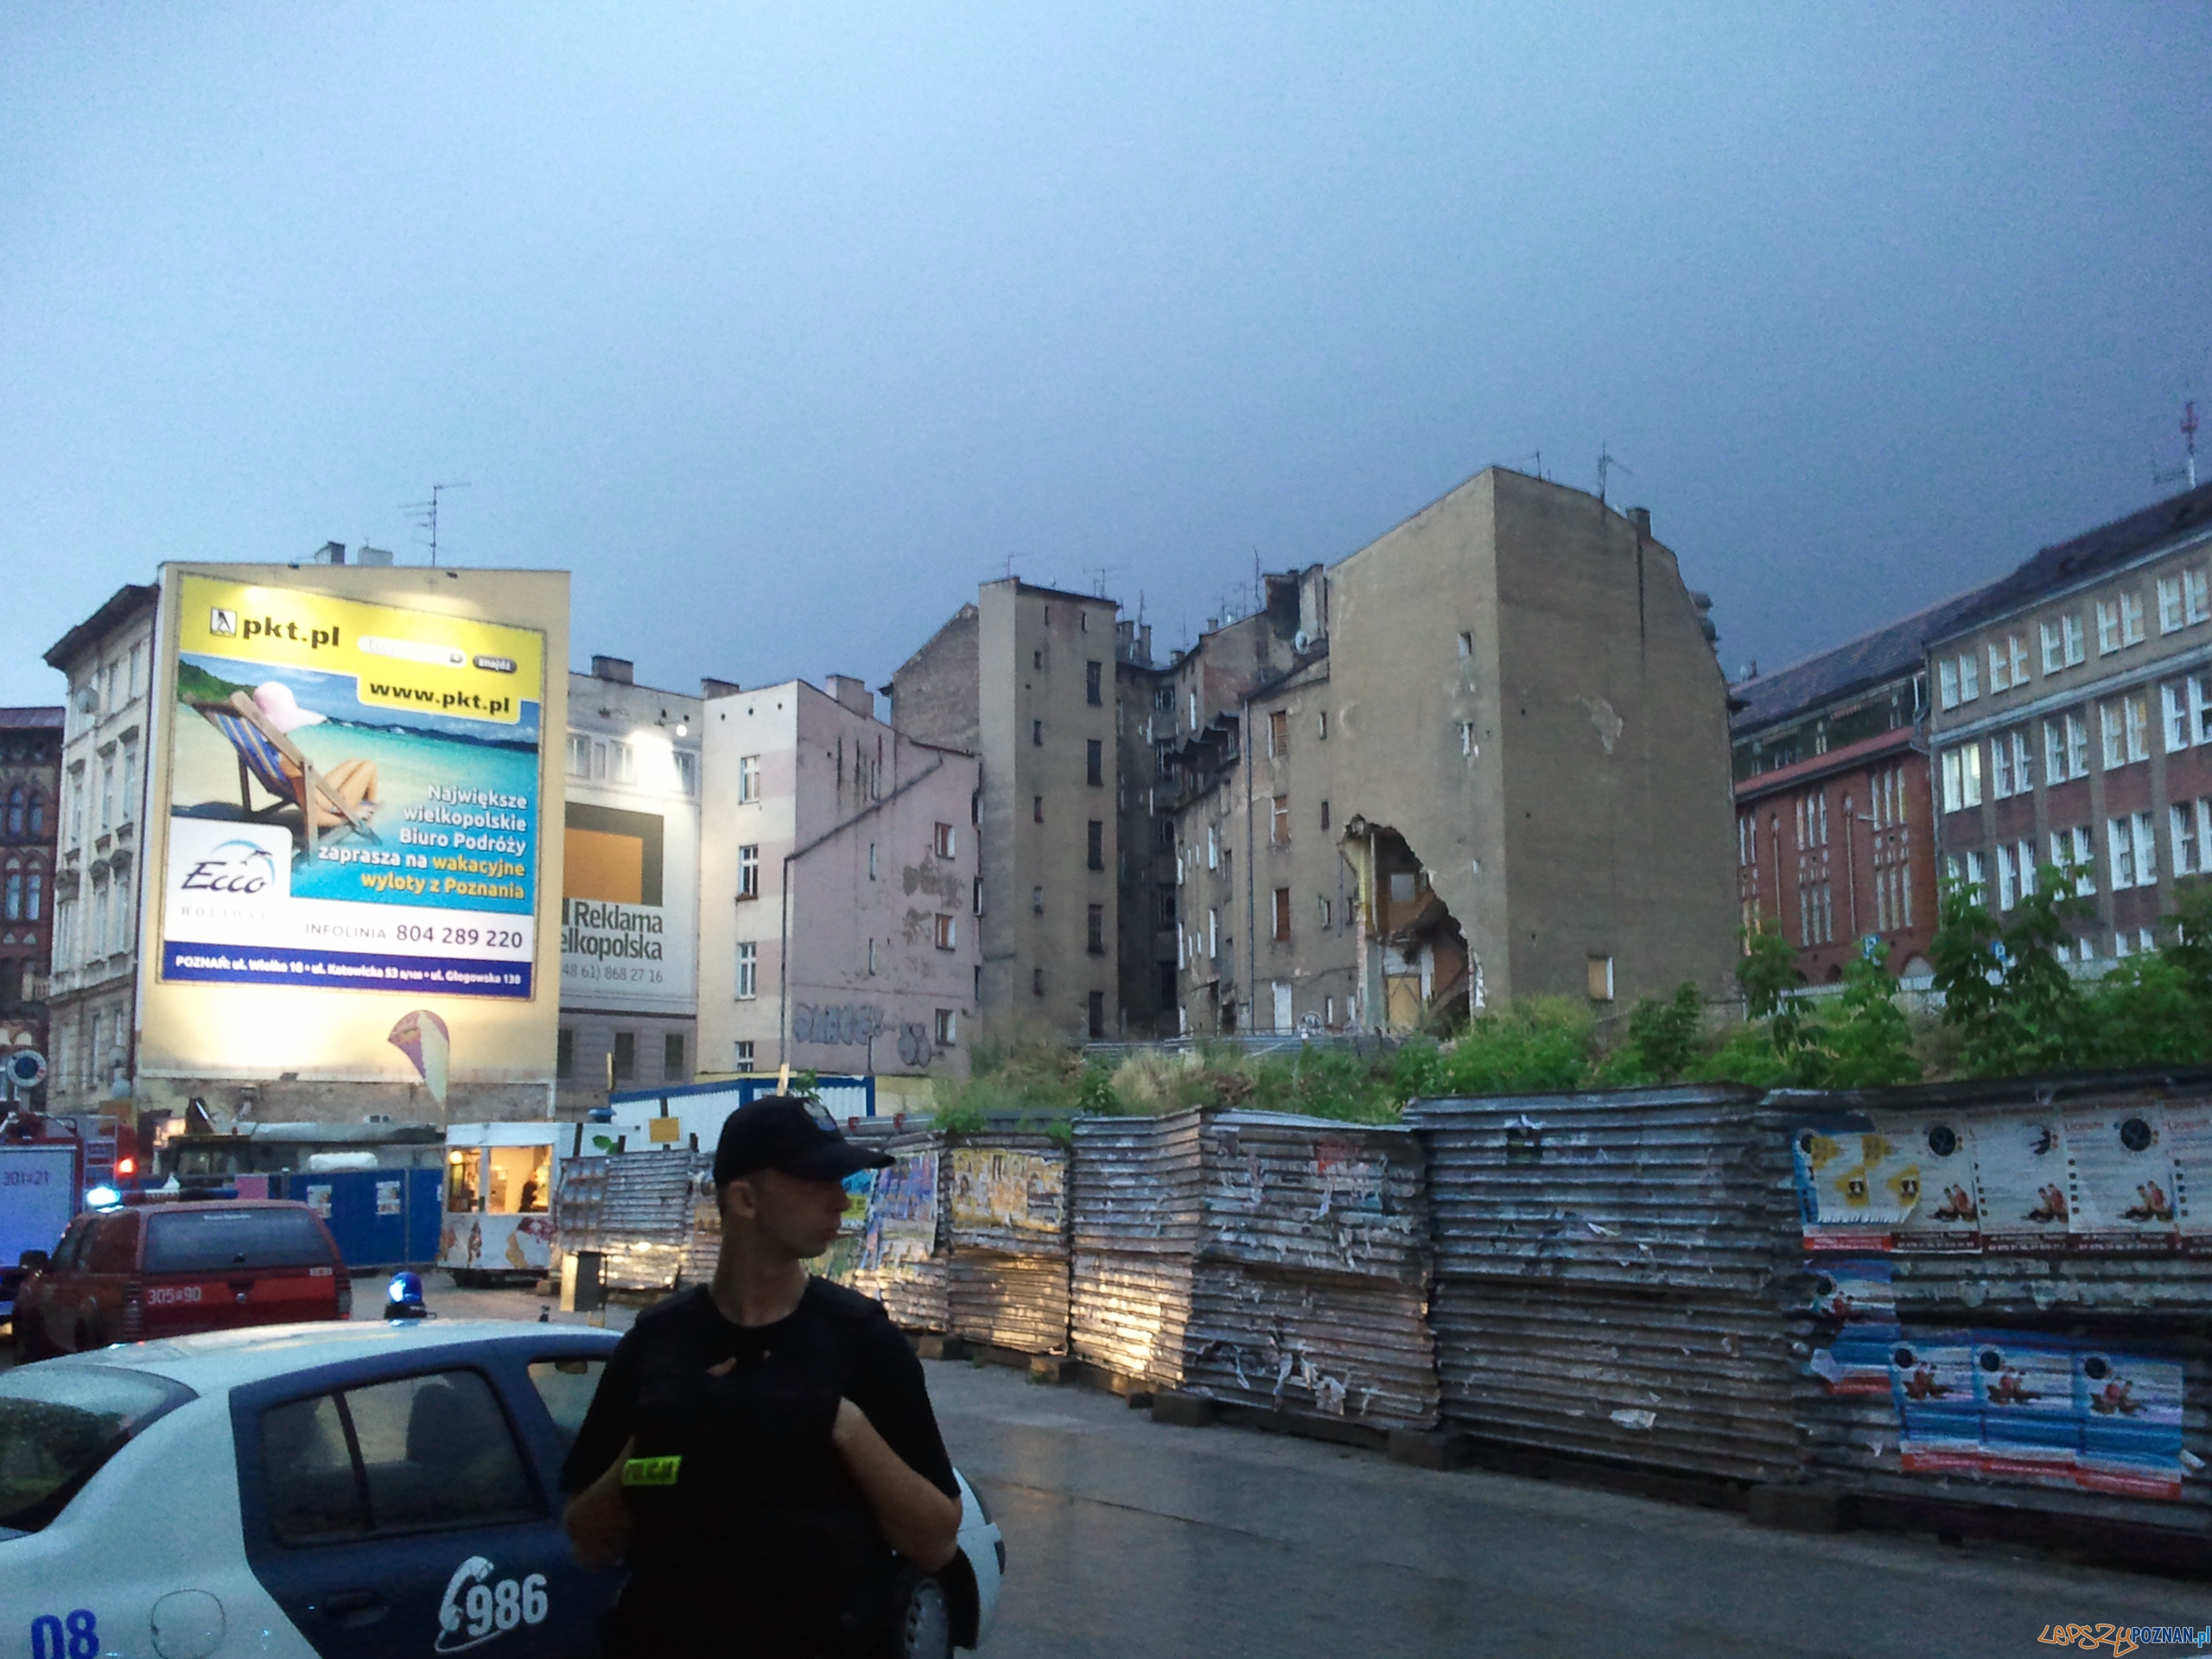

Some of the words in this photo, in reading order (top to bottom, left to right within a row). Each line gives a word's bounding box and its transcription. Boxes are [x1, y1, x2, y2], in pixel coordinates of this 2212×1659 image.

[243, 616, 340, 649] pkt.pl
[370, 683, 510, 715] www.pkt.pl
[428, 785, 528, 810] Największe
[404, 805, 528, 832] wielkopolskie
[400, 827, 448, 848] Biuro
[454, 832, 526, 856] Podróży
[181, 861, 267, 893] Ecco
[319, 845, 401, 868] zaprasza
[406, 857, 428, 869] na
[433, 855, 525, 878] wakacyjne
[361, 872, 426, 895] wyloty
[429, 880, 440, 893] z
[445, 878, 525, 899] Poznania
[574, 900, 664, 934] Reklama
[396, 924, 435, 943] 804
[442, 927, 480, 945] 289
[486, 930, 524, 949] 220
[581, 964, 601, 982] 61)
[605, 966, 627, 981] 868
[631, 968, 645, 982] 27
[649, 969, 664, 983] 16
[466, 1573, 549, 1637] 986
[31, 1608, 100, 1659] 08
